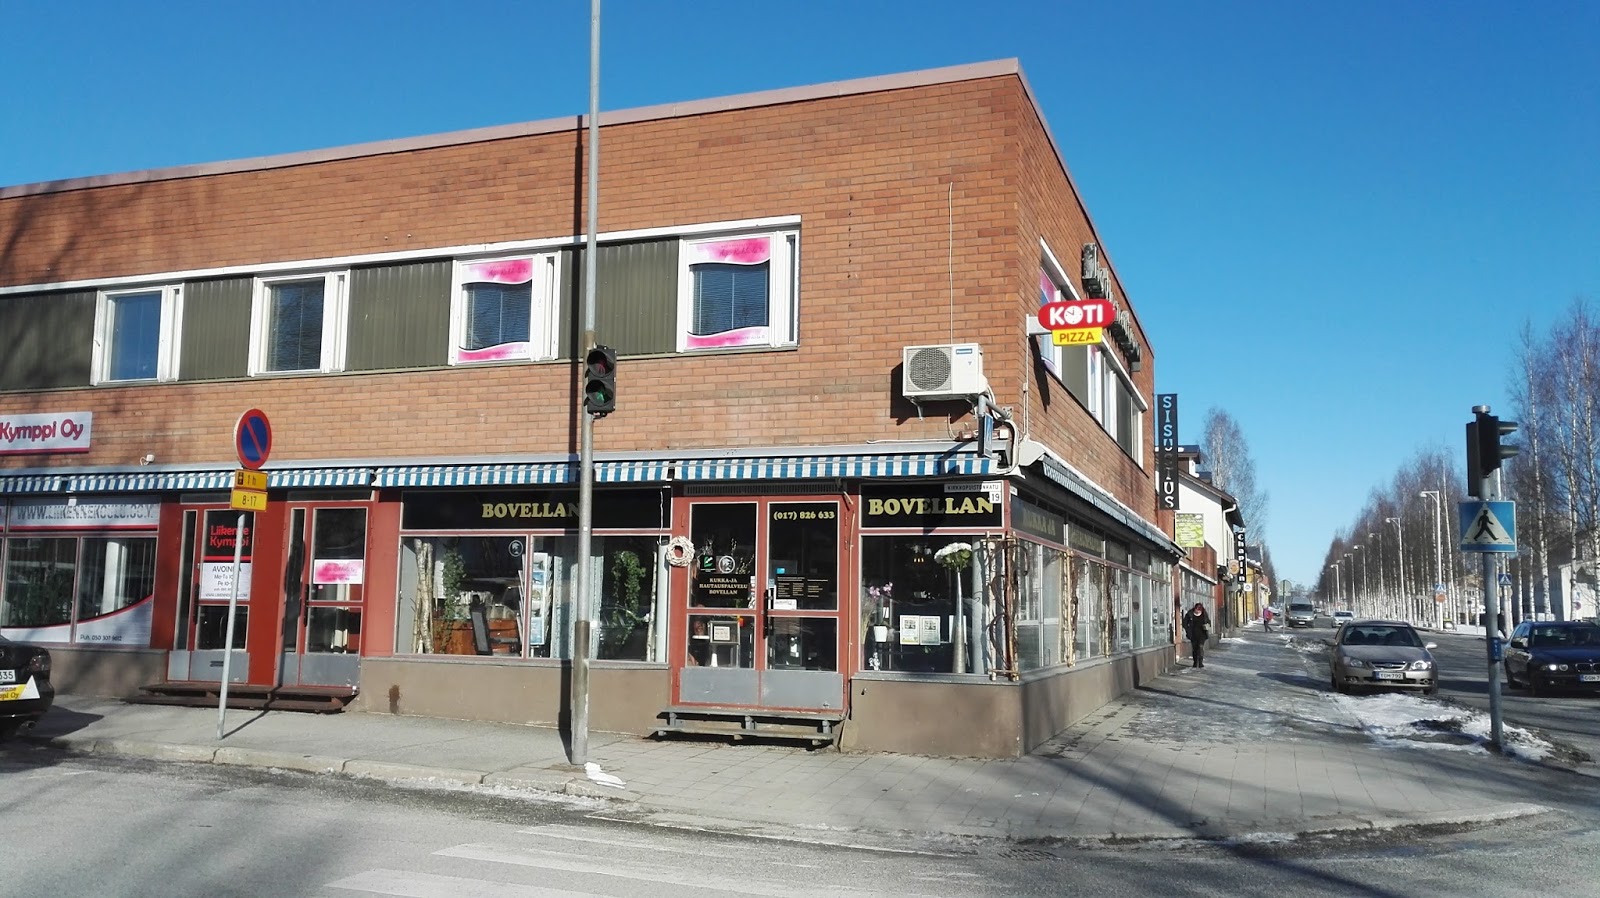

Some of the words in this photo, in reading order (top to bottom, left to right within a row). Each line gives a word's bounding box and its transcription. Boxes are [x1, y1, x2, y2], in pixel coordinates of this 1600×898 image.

[1049, 304, 1103, 326] KOTI
[1059, 331, 1095, 342] PIZZA
[0, 421, 57, 443] Kymppi
[60, 419, 83, 440] Oy
[1162, 395, 1175, 508] SISUSTUS
[242, 495, 257, 506] 8-17
[991, 493, 1000, 502] 19
[481, 502, 580, 518] BOVELLAN
[868, 497, 993, 515] BOVELLAN
[773, 511, 797, 520] (017)
[800, 511, 816, 519] 826
[818, 511, 835, 519] 633
[210, 525, 249, 536] Liikene
